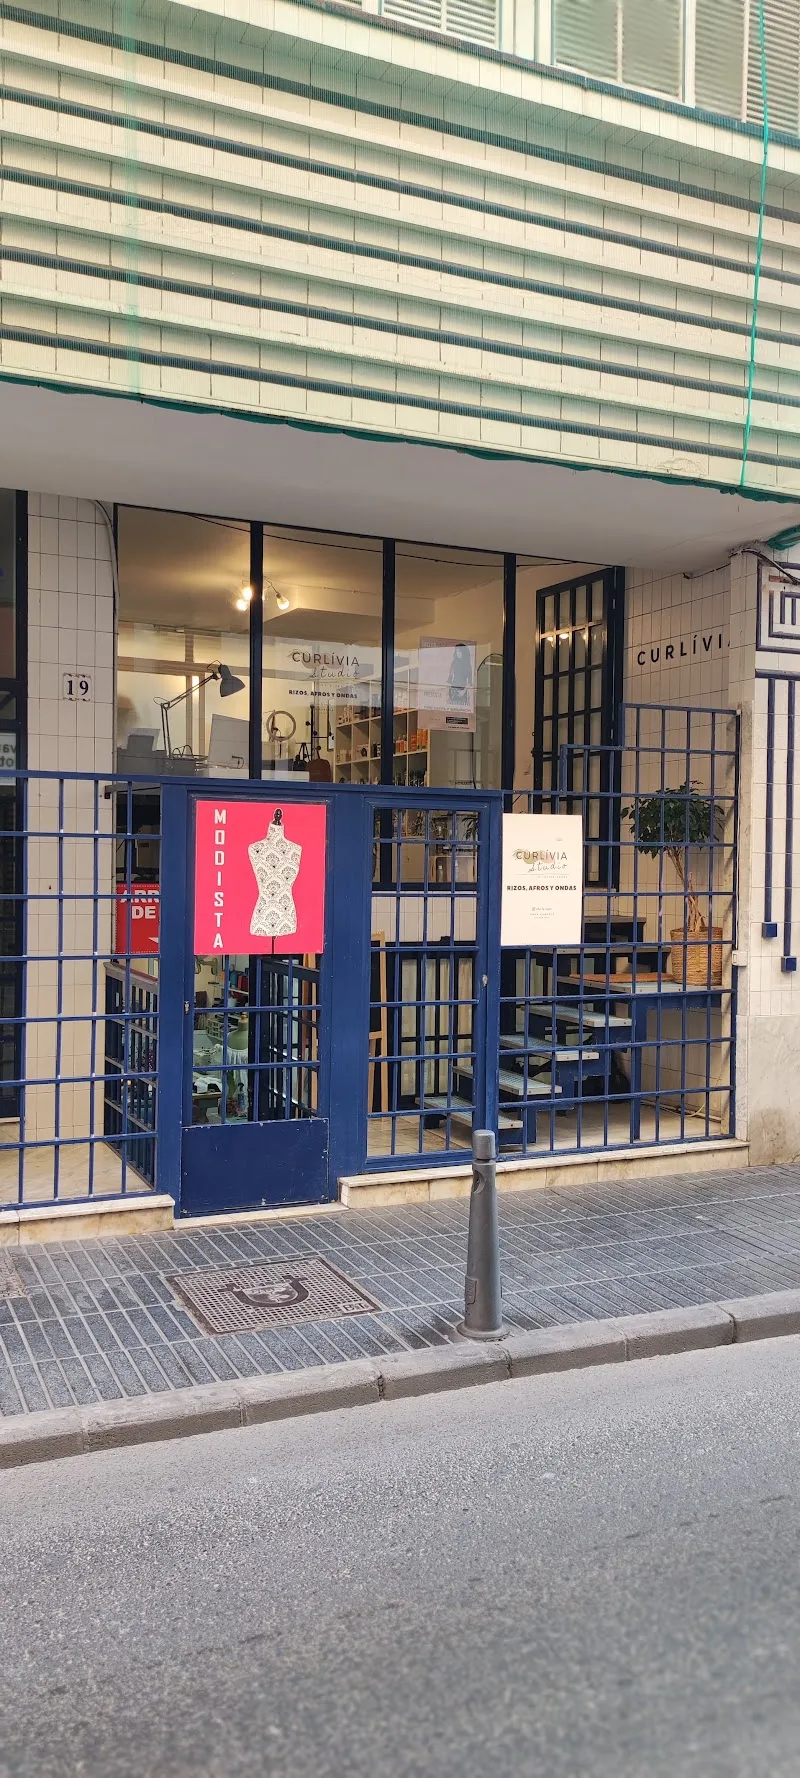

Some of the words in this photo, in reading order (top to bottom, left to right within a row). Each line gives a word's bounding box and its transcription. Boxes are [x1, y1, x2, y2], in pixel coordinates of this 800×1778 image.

[637, 633, 730, 666] CURLÍVI
[292, 652, 360, 667] CURLÍVIA
[67, 680, 89, 696] 19
[288, 689, 309, 697] RIZOS,
[515, 849, 568, 861] CURLÍVIA
[212, 808, 227, 949] MODISTA
[131, 905, 156, 919] DE
